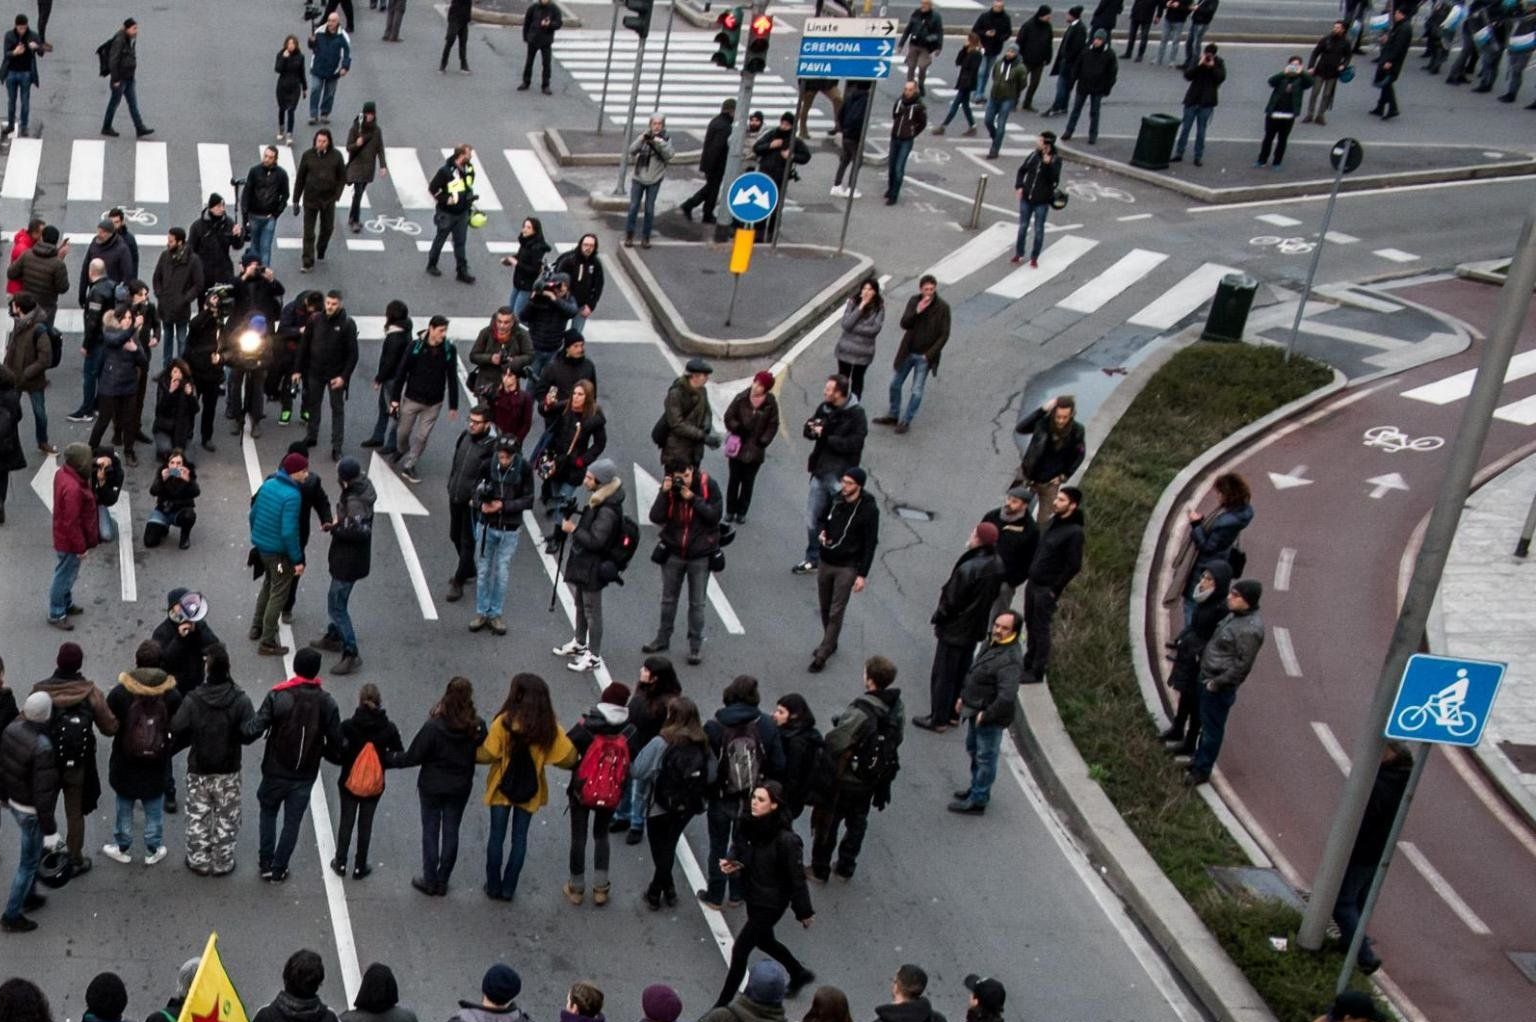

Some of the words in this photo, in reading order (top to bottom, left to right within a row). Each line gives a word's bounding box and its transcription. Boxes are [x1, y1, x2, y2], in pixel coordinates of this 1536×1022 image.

[807, 23, 838, 32] Linate
[802, 42, 860, 53] CREMONA
[799, 62, 832, 73] PAVIA
